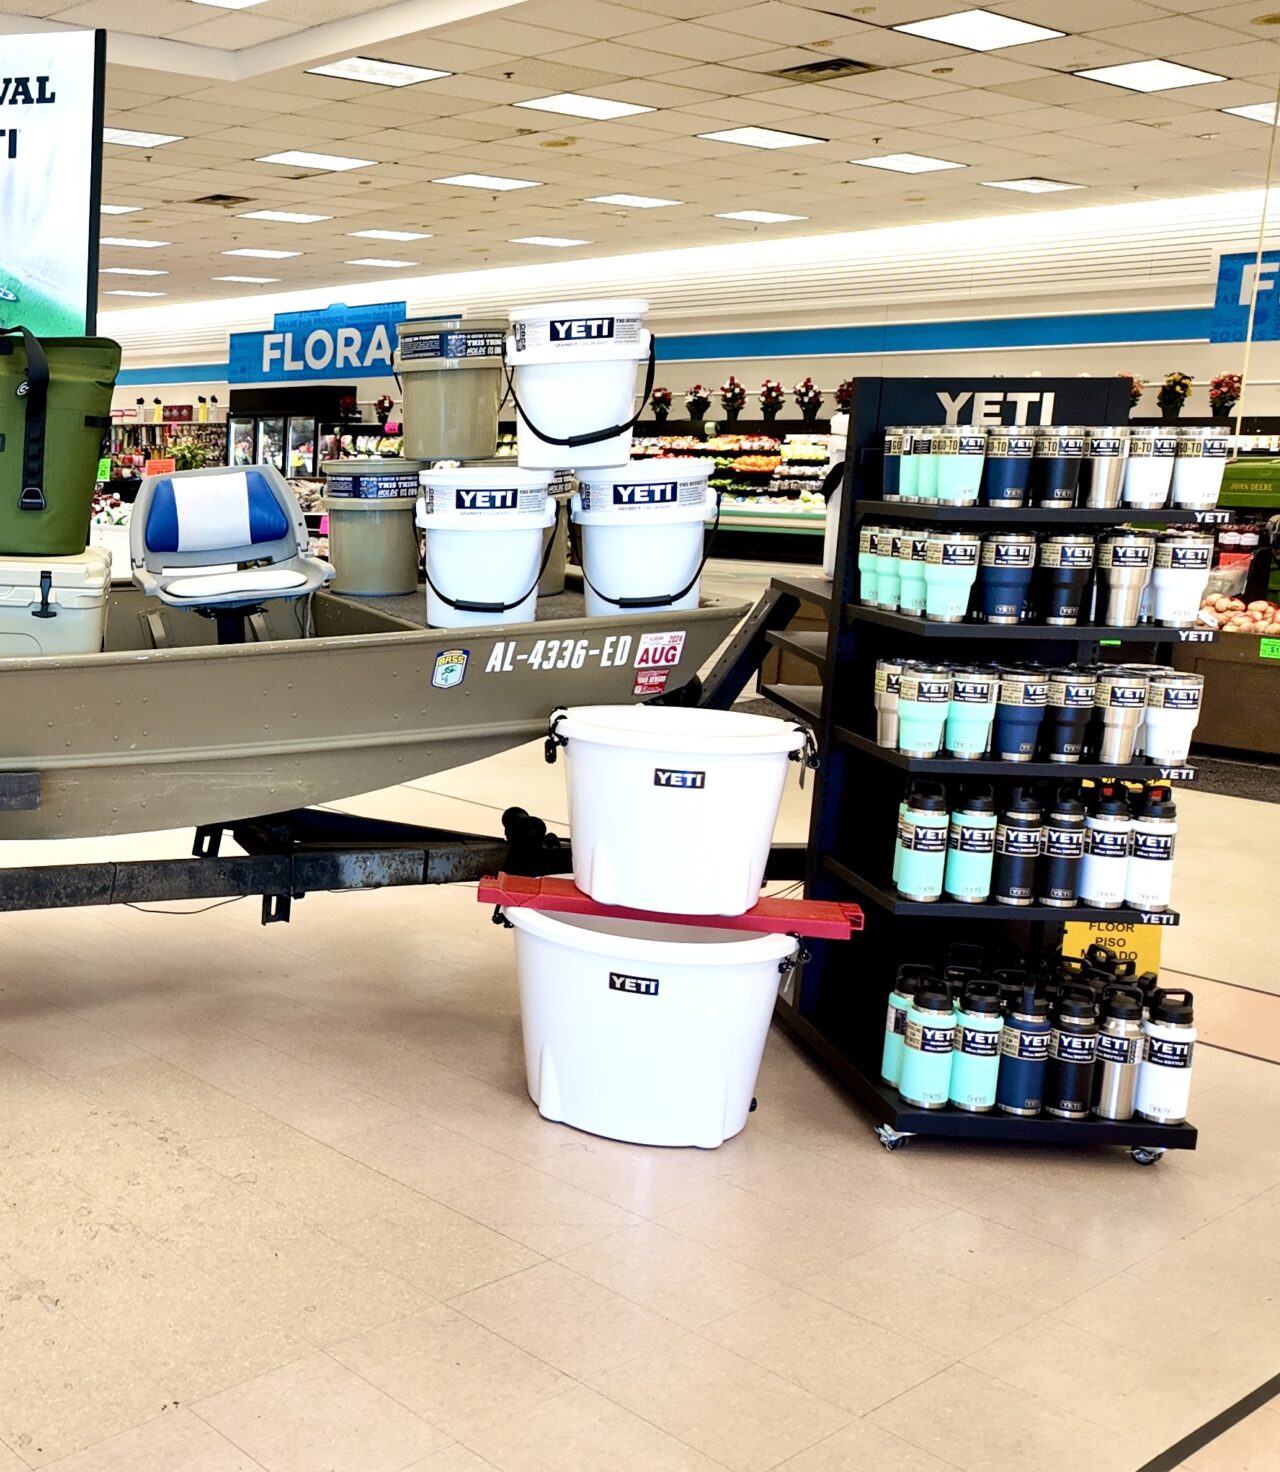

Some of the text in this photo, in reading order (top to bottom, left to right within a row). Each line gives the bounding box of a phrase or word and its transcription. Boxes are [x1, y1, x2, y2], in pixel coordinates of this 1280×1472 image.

[553, 319, 611, 339] YETI
[935, 391, 1057, 426] YETI
[960, 437, 985, 447] YETI
[1008, 438, 1033, 448] YETI
[1060, 438, 1084, 448] YETI
[1091, 438, 1120, 448] YETI
[616, 483, 674, 503] YETI
[1230, 483, 1273, 491] JOHN DEERE
[459, 490, 515, 508] YETI
[1194, 512, 1230, 523] YETI
[946, 545, 976, 556] YETI
[998, 545, 1030, 556] YETI
[1064, 546, 1092, 557] YETI
[1115, 546, 1148, 557] YETI
[1175, 547, 1208, 559] YETI
[1178, 630, 1214, 642] YETI
[485, 635, 633, 673] AL-4336-ED
[637, 645, 678, 666] AUG
[438, 655, 465, 666] BASS
[921, 683, 949, 693] YETI
[956, 682, 988, 693] YETI
[1069, 686, 1096, 696] YETI
[1113, 688, 1145, 698] YETI
[1168, 689, 1199, 699] YETI
[656, 769, 705, 788] YETI
[1159, 768, 1194, 780] YETI
[916, 828, 948, 840] YETI
[962, 828, 995, 841] YETI
[1007, 830, 1040, 842] YETI
[1049, 831, 1082, 843] YETI
[1093, 833, 1127, 845] YETI
[1136, 834, 1171, 847] YETI
[1140, 913, 1175, 925] YETI
[1088, 922, 1135, 933] FLOOR
[1095, 937, 1127, 947] PISO
[611, 974, 658, 993] YETI
[923, 1028, 955, 1041] YETI
[965, 1030, 998, 1044] YETI
[1060, 1035, 1095, 1048] YETI
[1151, 1039, 1188, 1055] YETI
